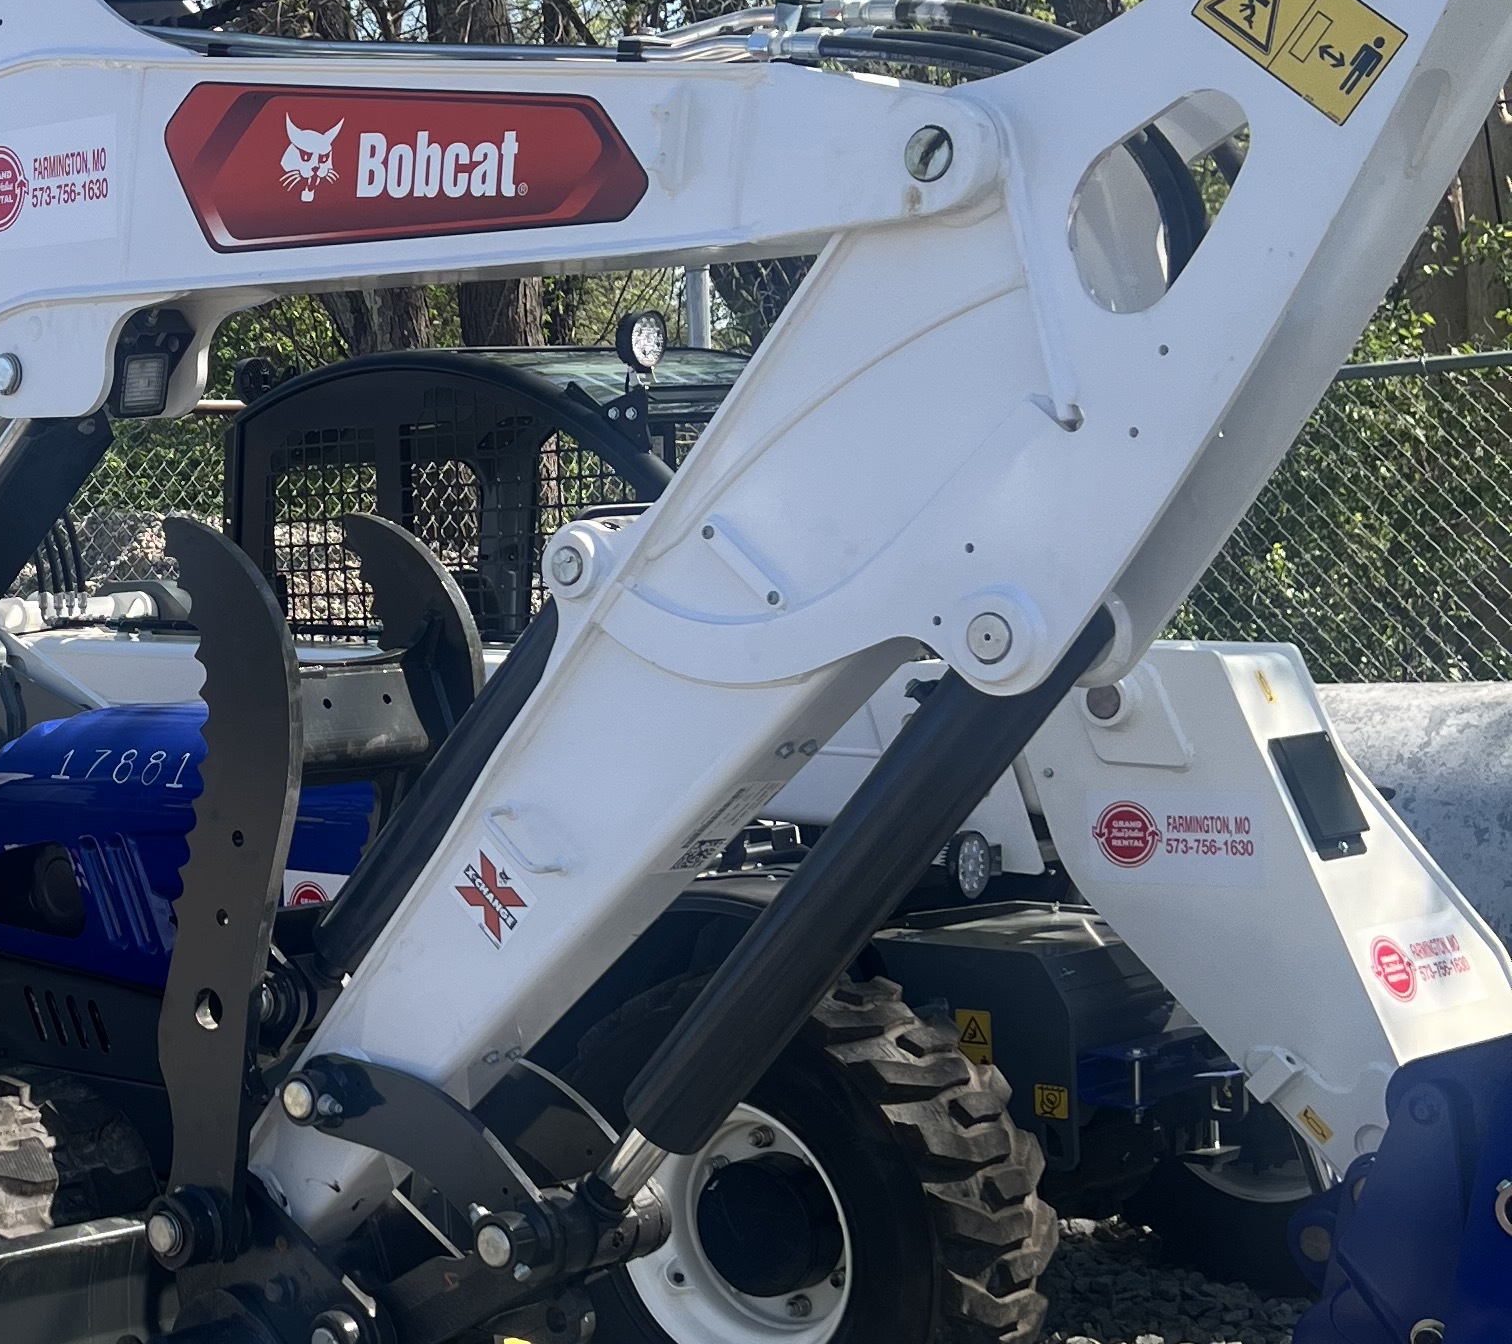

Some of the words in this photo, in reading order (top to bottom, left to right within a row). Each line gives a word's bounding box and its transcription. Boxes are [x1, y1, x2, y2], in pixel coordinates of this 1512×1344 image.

[33, 150, 91, 181] FARMINGTON,
[92, 147, 107, 172] MO
[31, 178, 109, 208] 573-756-1630
[50, 748, 191, 789] 17881
[1166, 815, 1233, 837] FARMINGTON,
[1234, 816, 1251, 835] MO
[1165, 838, 1254, 857] 573-756-1630
